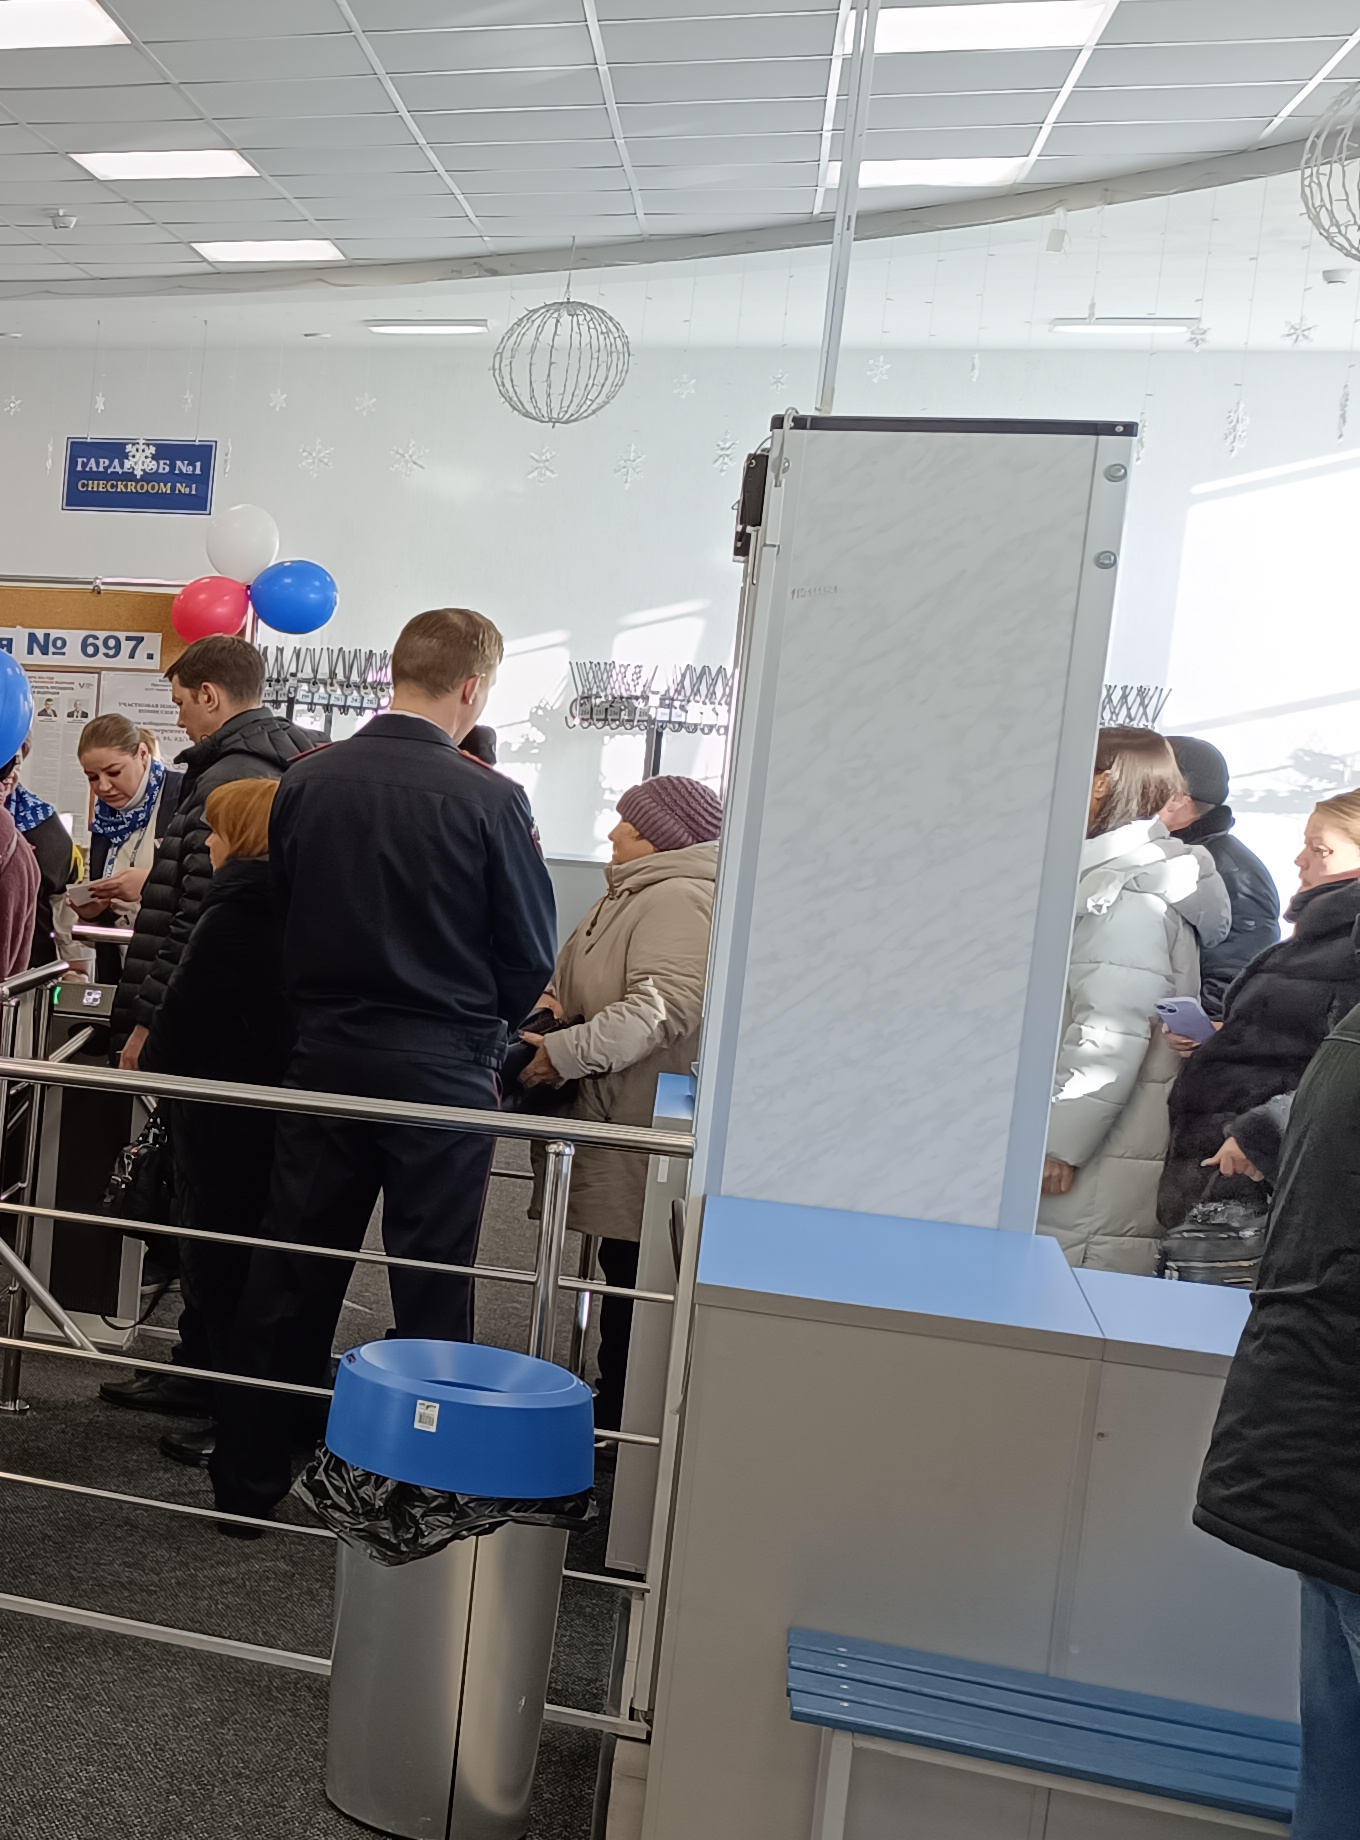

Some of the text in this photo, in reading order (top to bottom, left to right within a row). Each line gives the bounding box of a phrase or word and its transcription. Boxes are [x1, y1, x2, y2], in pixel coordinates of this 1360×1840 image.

[76, 458, 201, 474] ГАРДЕОБ №1
[78, 480, 197, 494] CHECKROOM №1
[27, 633, 67, 656] №
[80, 634, 155, 660] 697.
